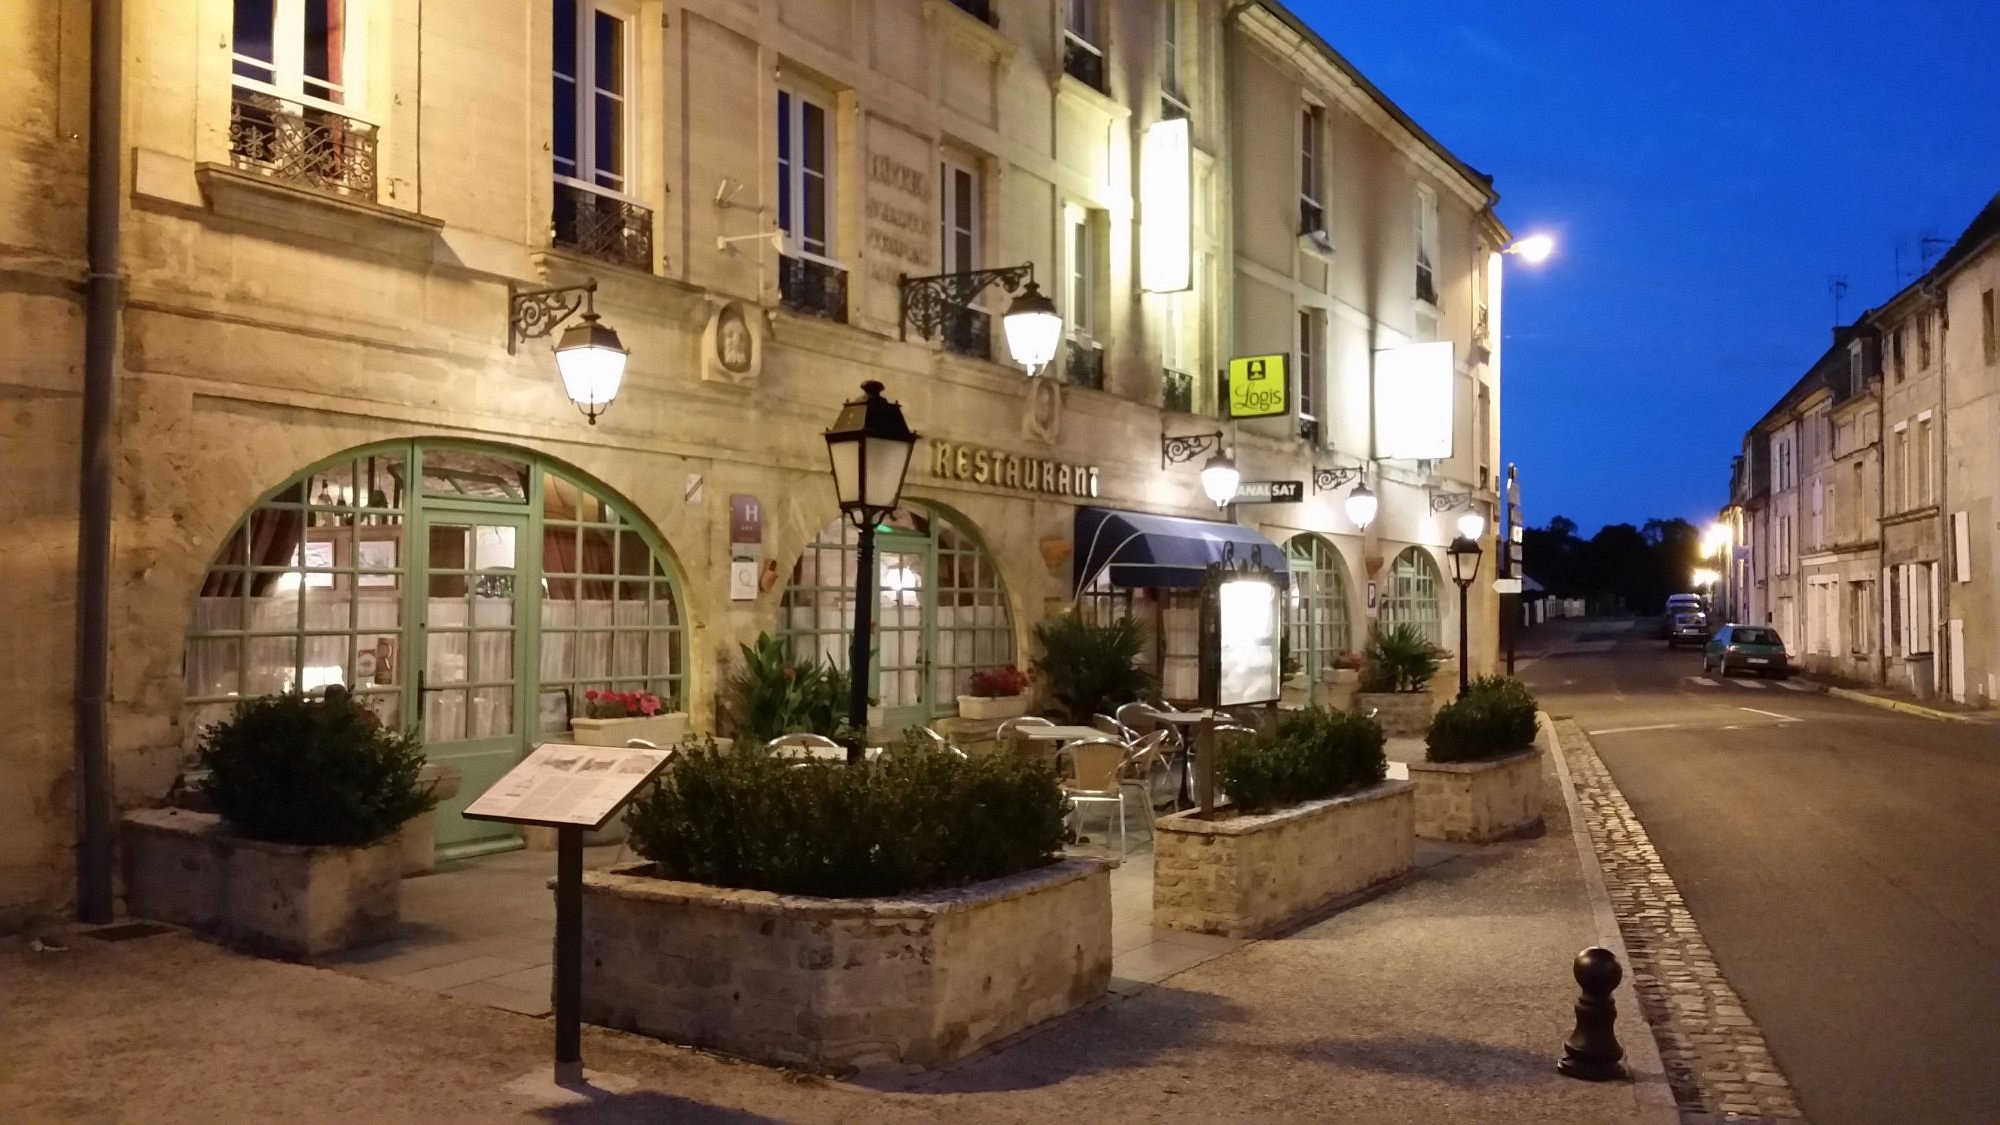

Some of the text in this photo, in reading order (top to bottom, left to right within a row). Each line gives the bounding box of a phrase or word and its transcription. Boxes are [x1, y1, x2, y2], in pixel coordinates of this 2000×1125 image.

[1233, 382, 1282, 411] Logis
[1236, 484, 1296, 497] ANALSAT
[745, 504, 758, 522] H
[1368, 585, 1375, 606] P
